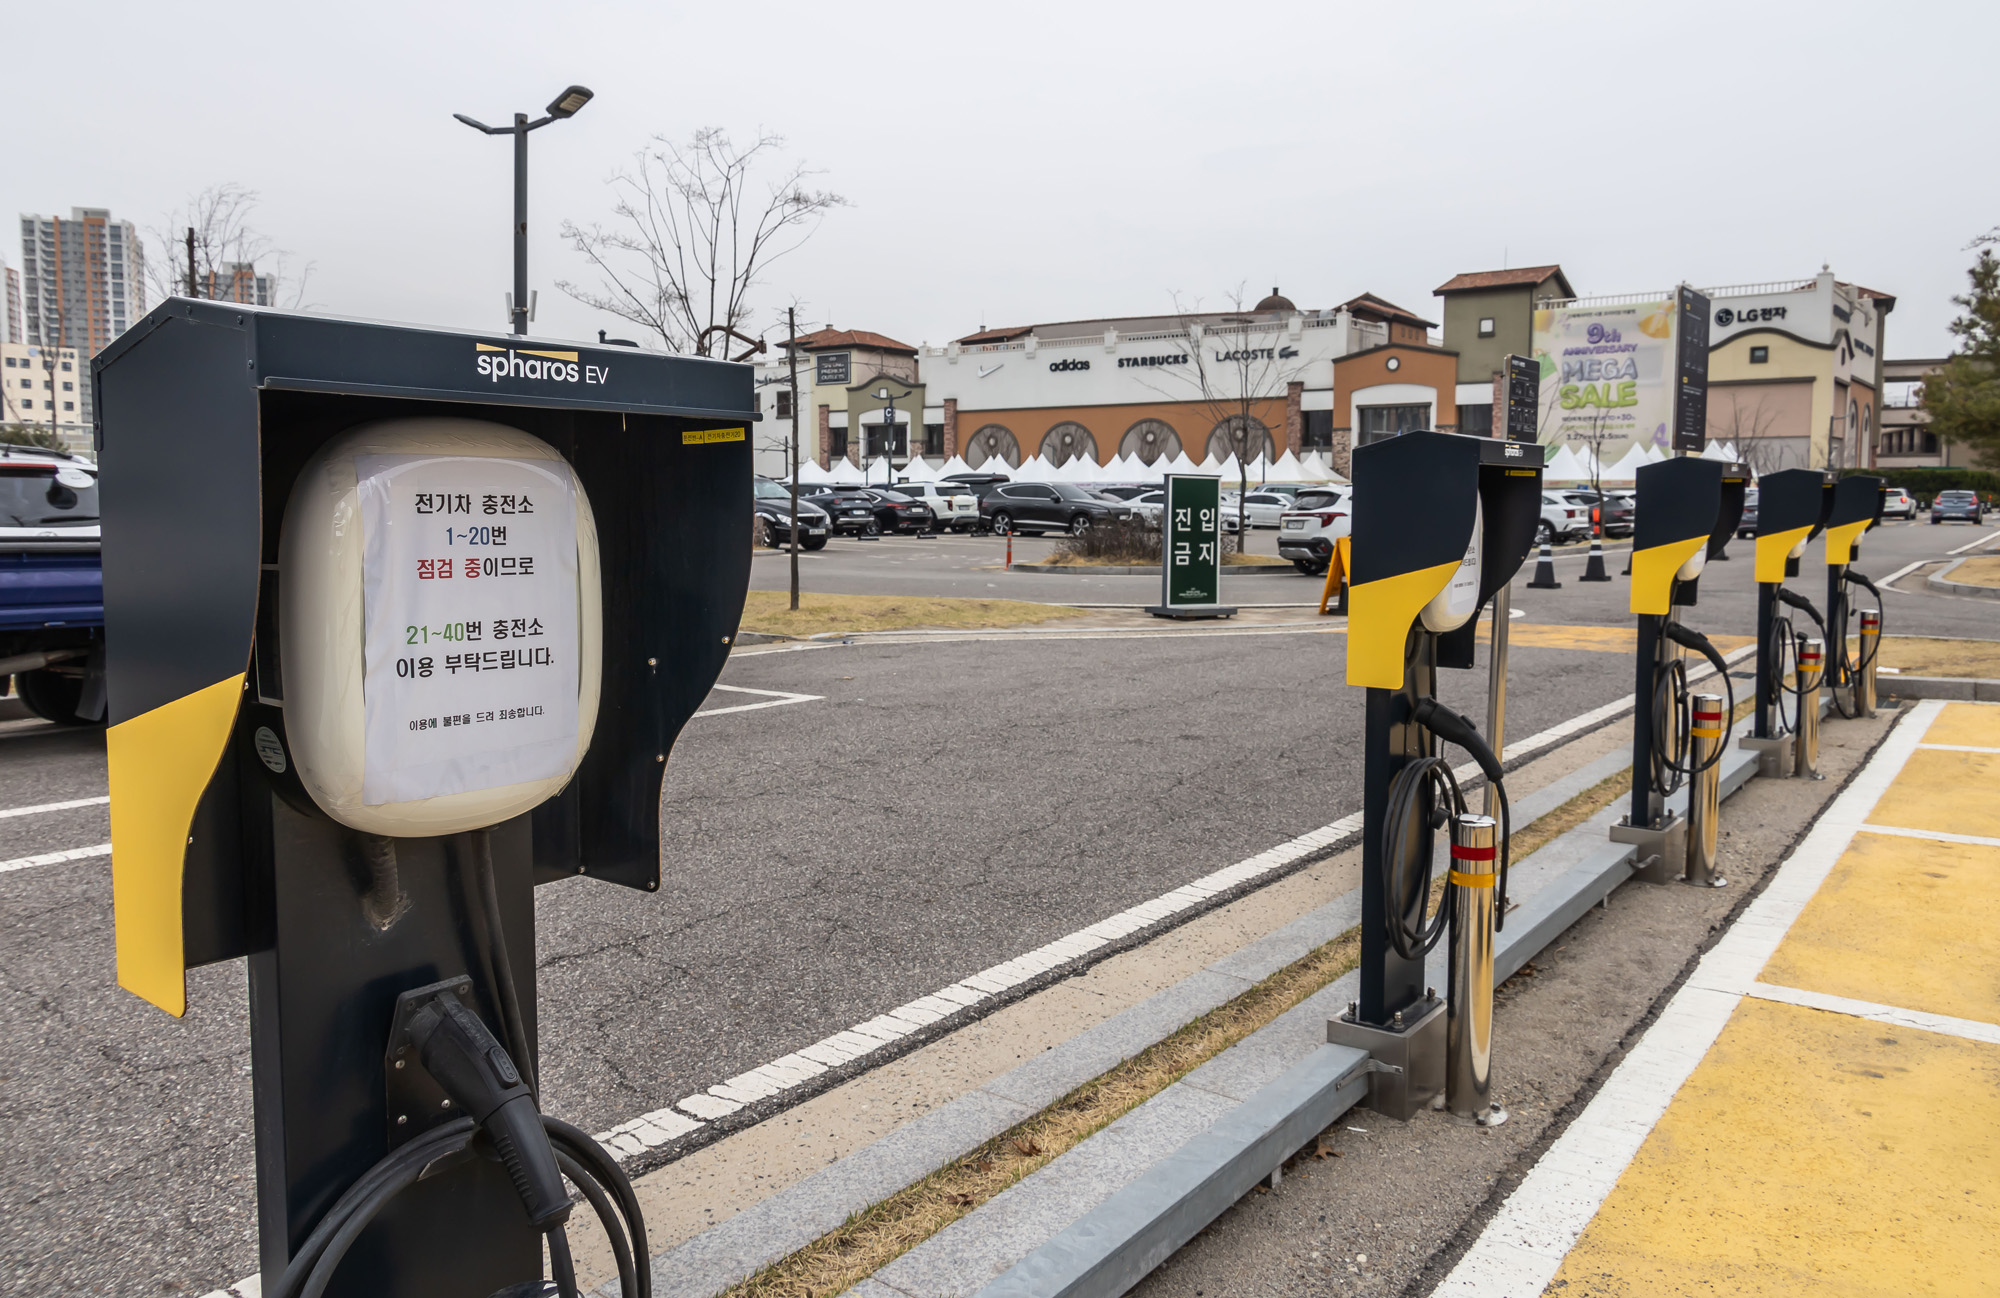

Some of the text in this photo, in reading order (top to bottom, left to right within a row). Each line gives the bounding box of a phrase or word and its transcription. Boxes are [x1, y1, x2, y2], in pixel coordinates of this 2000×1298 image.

[1587, 323, 1622, 344] 9th
[1117, 354, 1188, 368] STARBUCKS
[1215, 348, 1275, 362] LACOSTE
[1563, 343, 1638, 357] ANNIVERSARY
[477, 349, 609, 385] spharos EV
[1049, 358, 1090, 372] adidas
[1562, 357, 1638, 384] MEGA
[1559, 380, 1638, 410] SALE
[885, 408, 892, 417] C
[415, 493, 534, 515] 전기차 충전소
[1175, 507, 1215, 532] 진입
[446, 526, 507, 546] 1~20번
[1174, 541, 1214, 566] 금지
[416, 557, 535, 580] 점검 중이므로
[406, 617, 544, 645] 21~40번 충전소
[396, 647, 554, 679] 이용 부탁드립니다.
[409, 705, 545, 731] 이용에 불편을 드려 죄송합니다.
